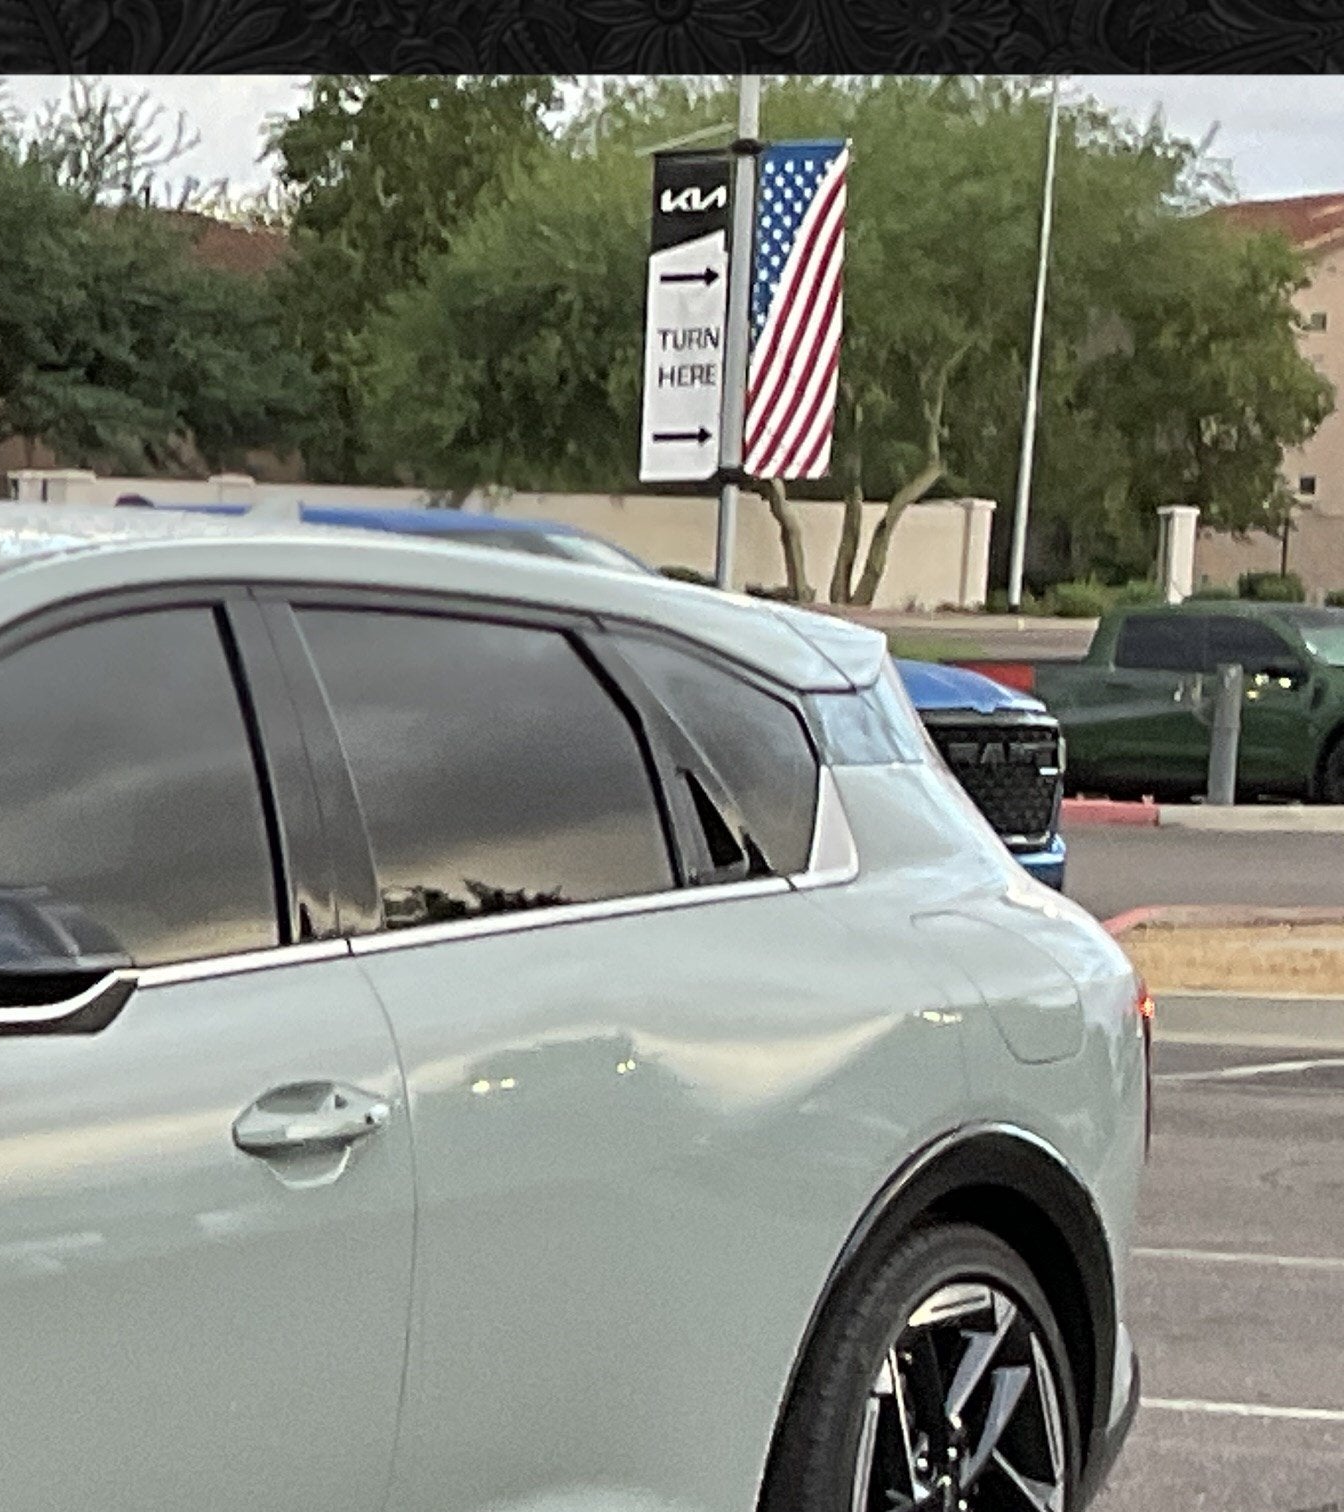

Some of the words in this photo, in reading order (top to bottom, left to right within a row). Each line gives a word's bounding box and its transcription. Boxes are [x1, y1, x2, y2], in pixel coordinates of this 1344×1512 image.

[660, 185, 727, 213] KIA
[658, 327, 720, 351] TURN
[658, 364, 716, 388] HERE
